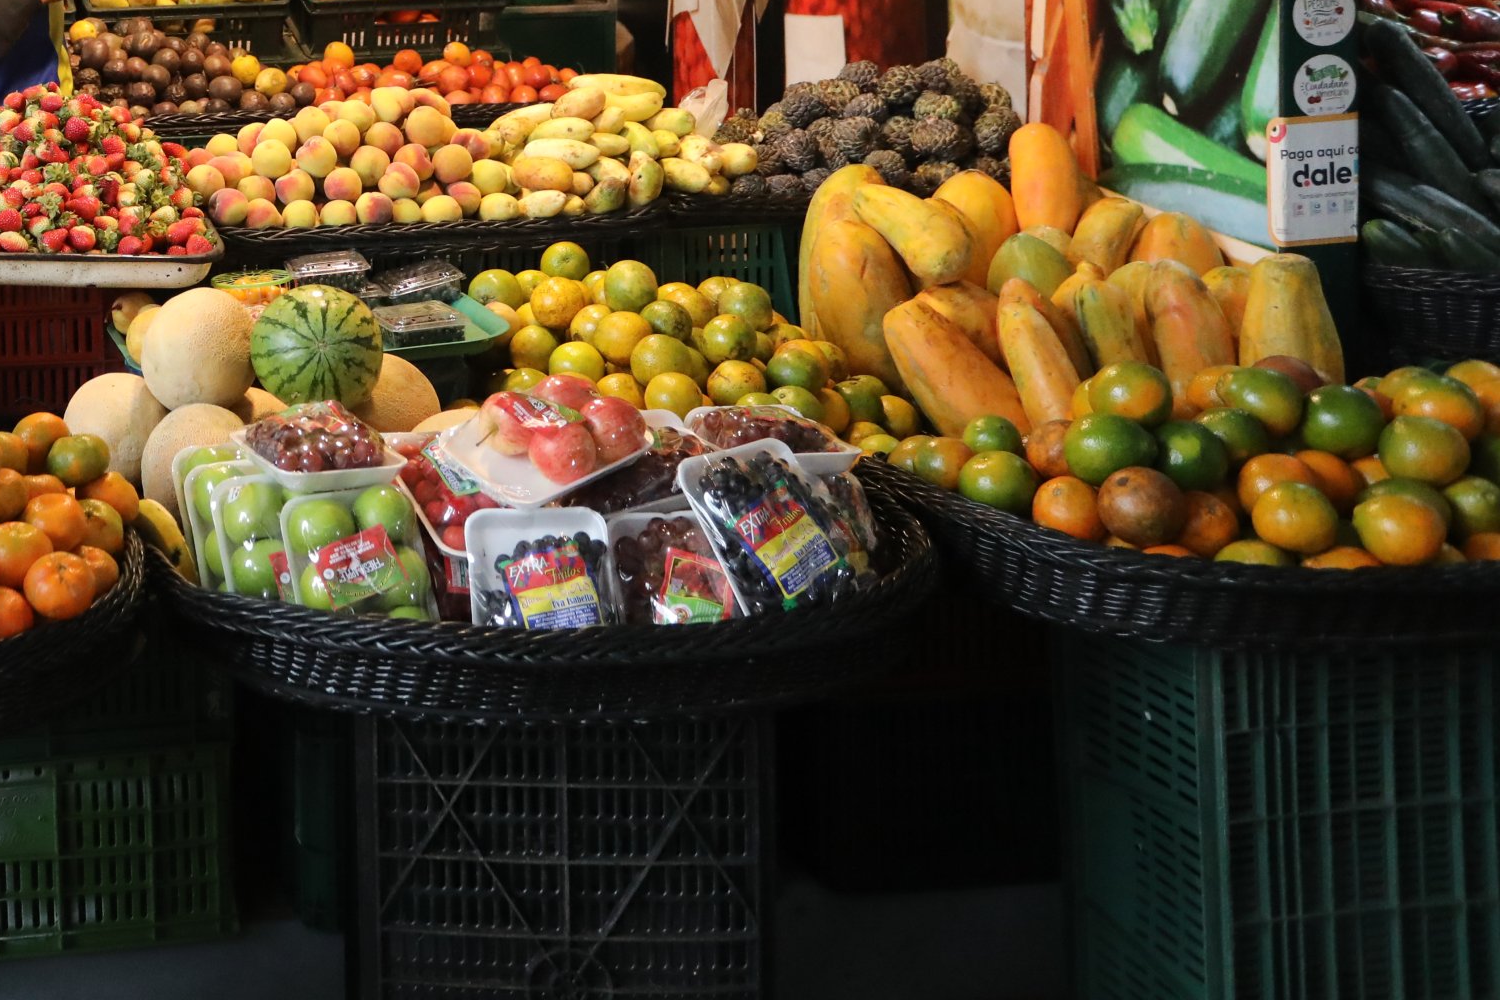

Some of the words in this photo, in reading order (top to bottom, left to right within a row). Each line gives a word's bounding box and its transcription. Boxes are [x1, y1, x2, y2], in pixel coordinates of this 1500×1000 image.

[1280, 149, 1313, 162] Paga
[1317, 145, 1344, 158] aquí
[1292, 161, 1352, 188] dale
[739, 507, 771, 545] EXTRA
[508, 553, 550, 588] EXTRA
